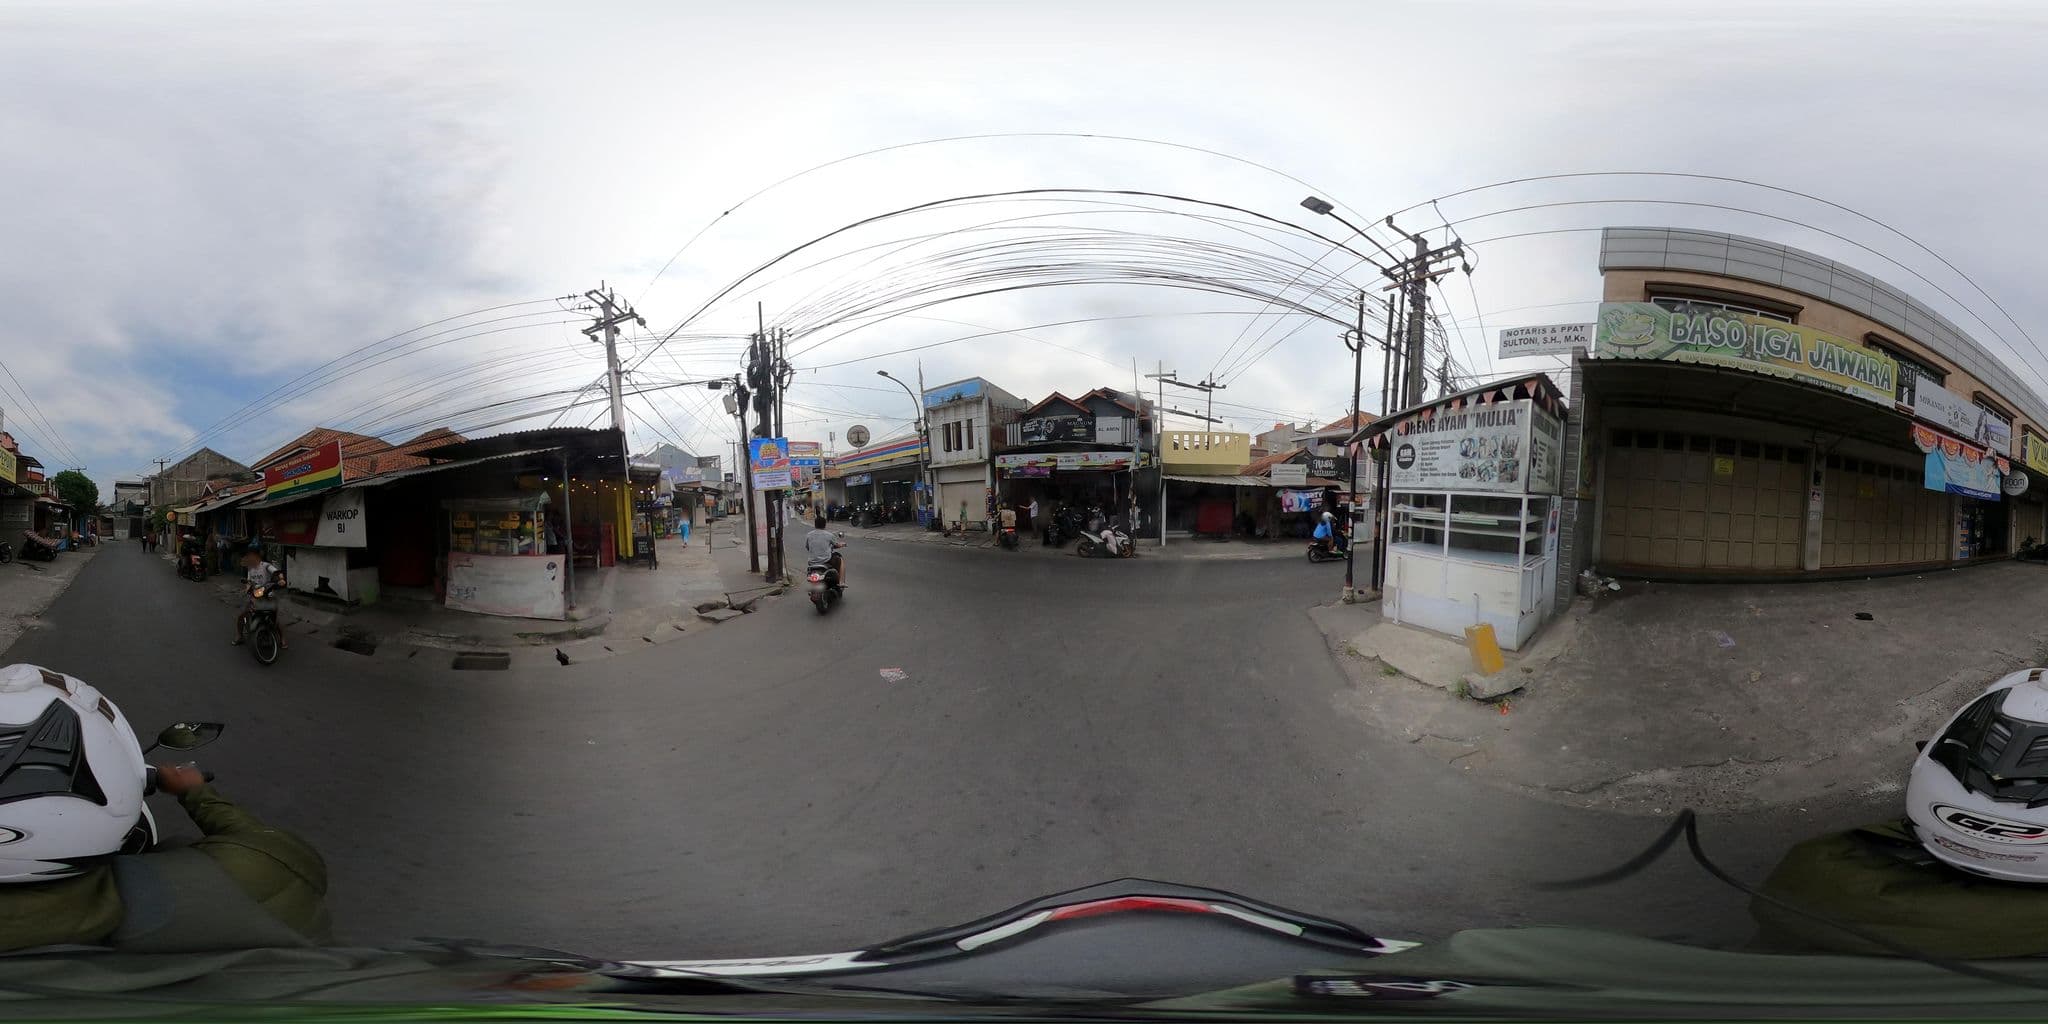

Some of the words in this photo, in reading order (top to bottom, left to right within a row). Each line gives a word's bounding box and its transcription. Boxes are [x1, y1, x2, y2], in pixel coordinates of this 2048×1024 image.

[1506, 328, 1547, 337] NOTARIS
[1503, 337, 1540, 348] SULTONI,
[1669, 312, 1747, 349] BASO
[1753, 325, 1803, 363] IGA
[1807, 340, 1893, 392] JAWARA
[1438, 414, 1467, 432] AYAM
[1470, 408, 1523, 428] "MULIA"
[326, 509, 359, 521] WARKOP
[337, 522, 346, 533] BJ
[1946, 812, 2046, 839] G2
